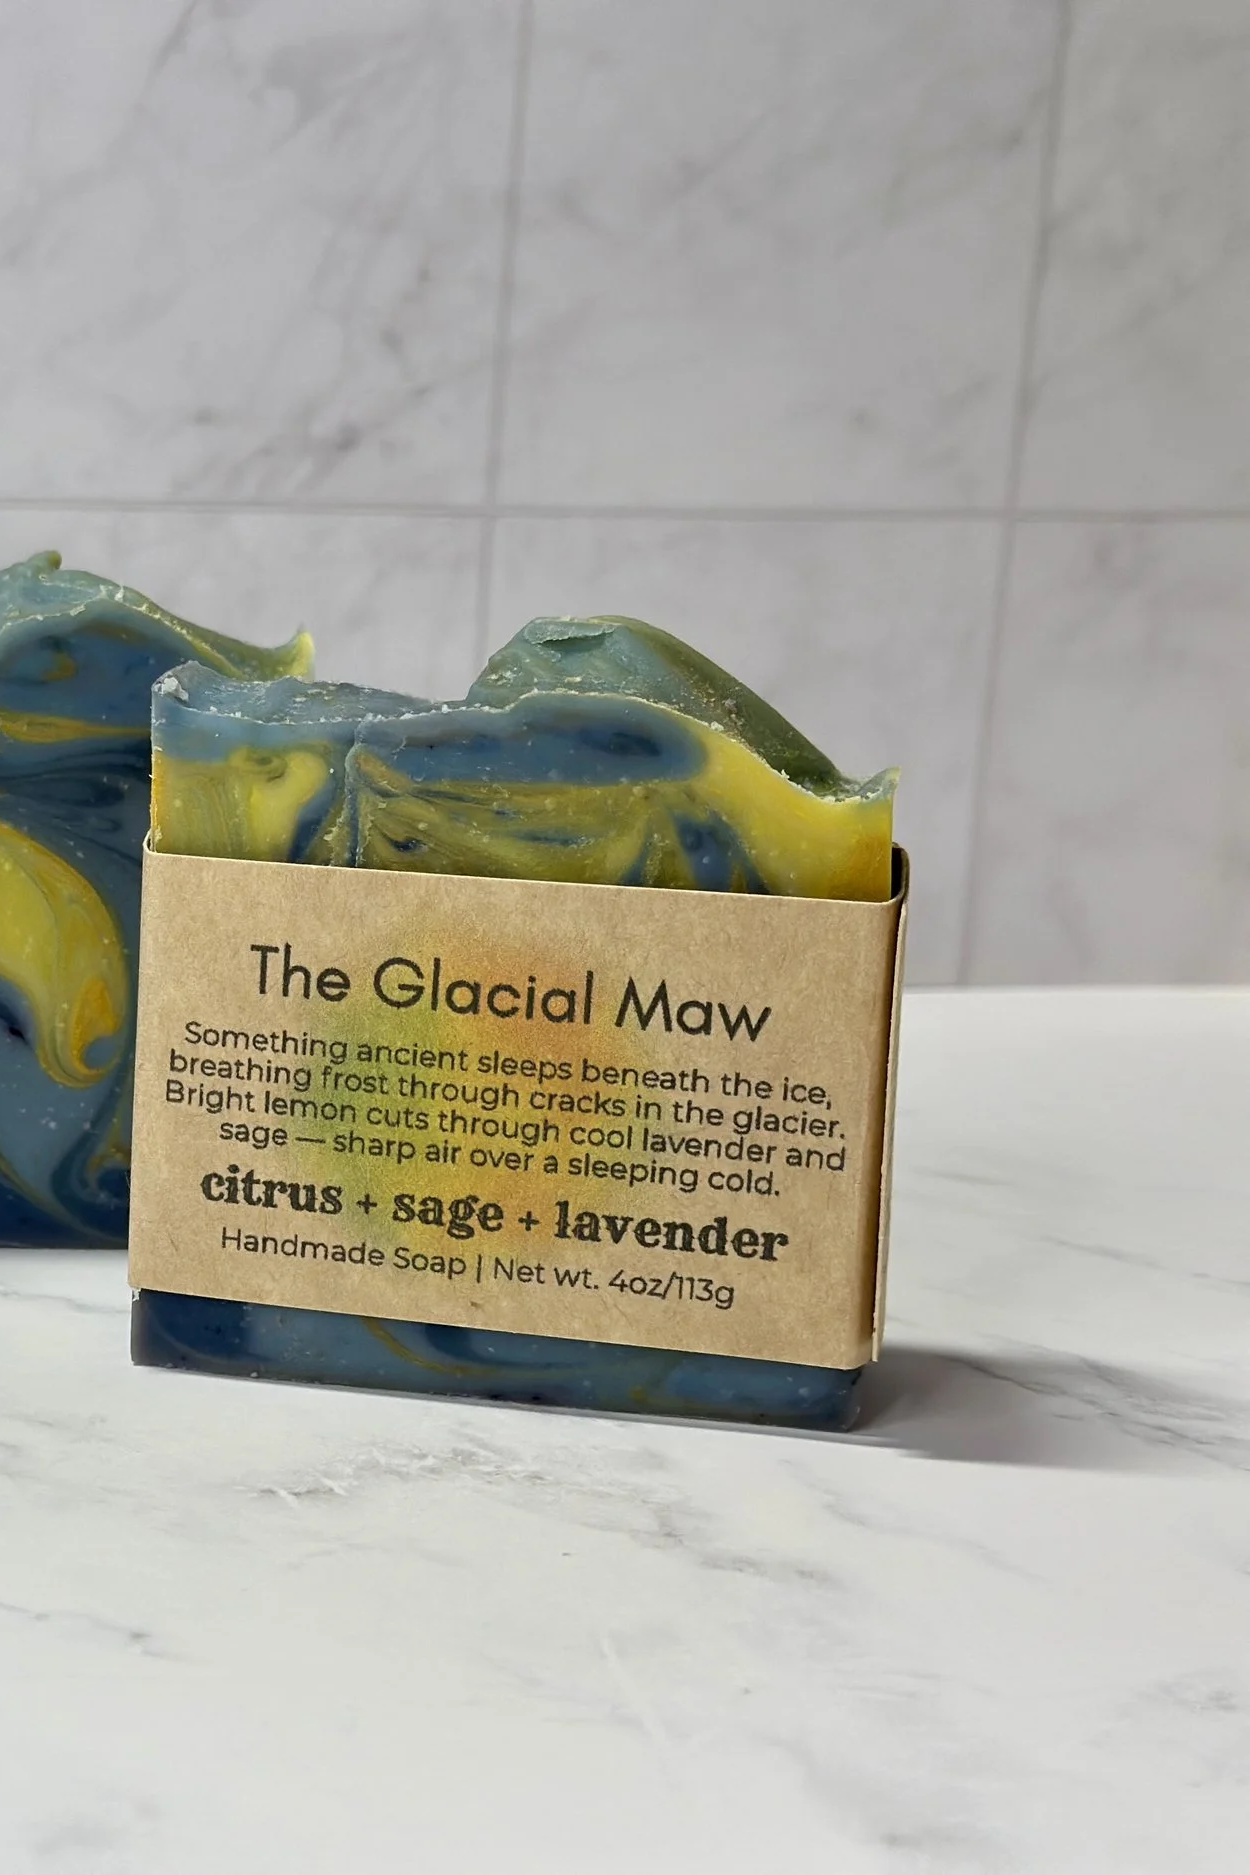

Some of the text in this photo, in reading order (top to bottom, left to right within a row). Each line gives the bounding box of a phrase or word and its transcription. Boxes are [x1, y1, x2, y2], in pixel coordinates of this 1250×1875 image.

[250, 942, 772, 1042] The Glacial Maw
[170, 1048, 845, 1139] breathing frost through cracks in the glacier.
[185, 1021, 831, 1110] Something ancient sleeps beneath the ice,
[166, 1079, 846, 1171] Bright lemon cuts through cool lavender and
[219, 1122, 288, 1149] sage
[333, 1130, 416, 1164] sharp
[425, 1140, 461, 1164] air
[470, 1148, 534, 1171] over
[544, 1155, 558, 1174] a
[568, 1153, 698, 1193] sleeping
[708, 1169, 779, 1197] cold.
[200, 1164, 789, 1262] citrus + sage + lavender
[222, 1227, 734, 1310] Handmade Soap | Net wt. 4oz/113g
